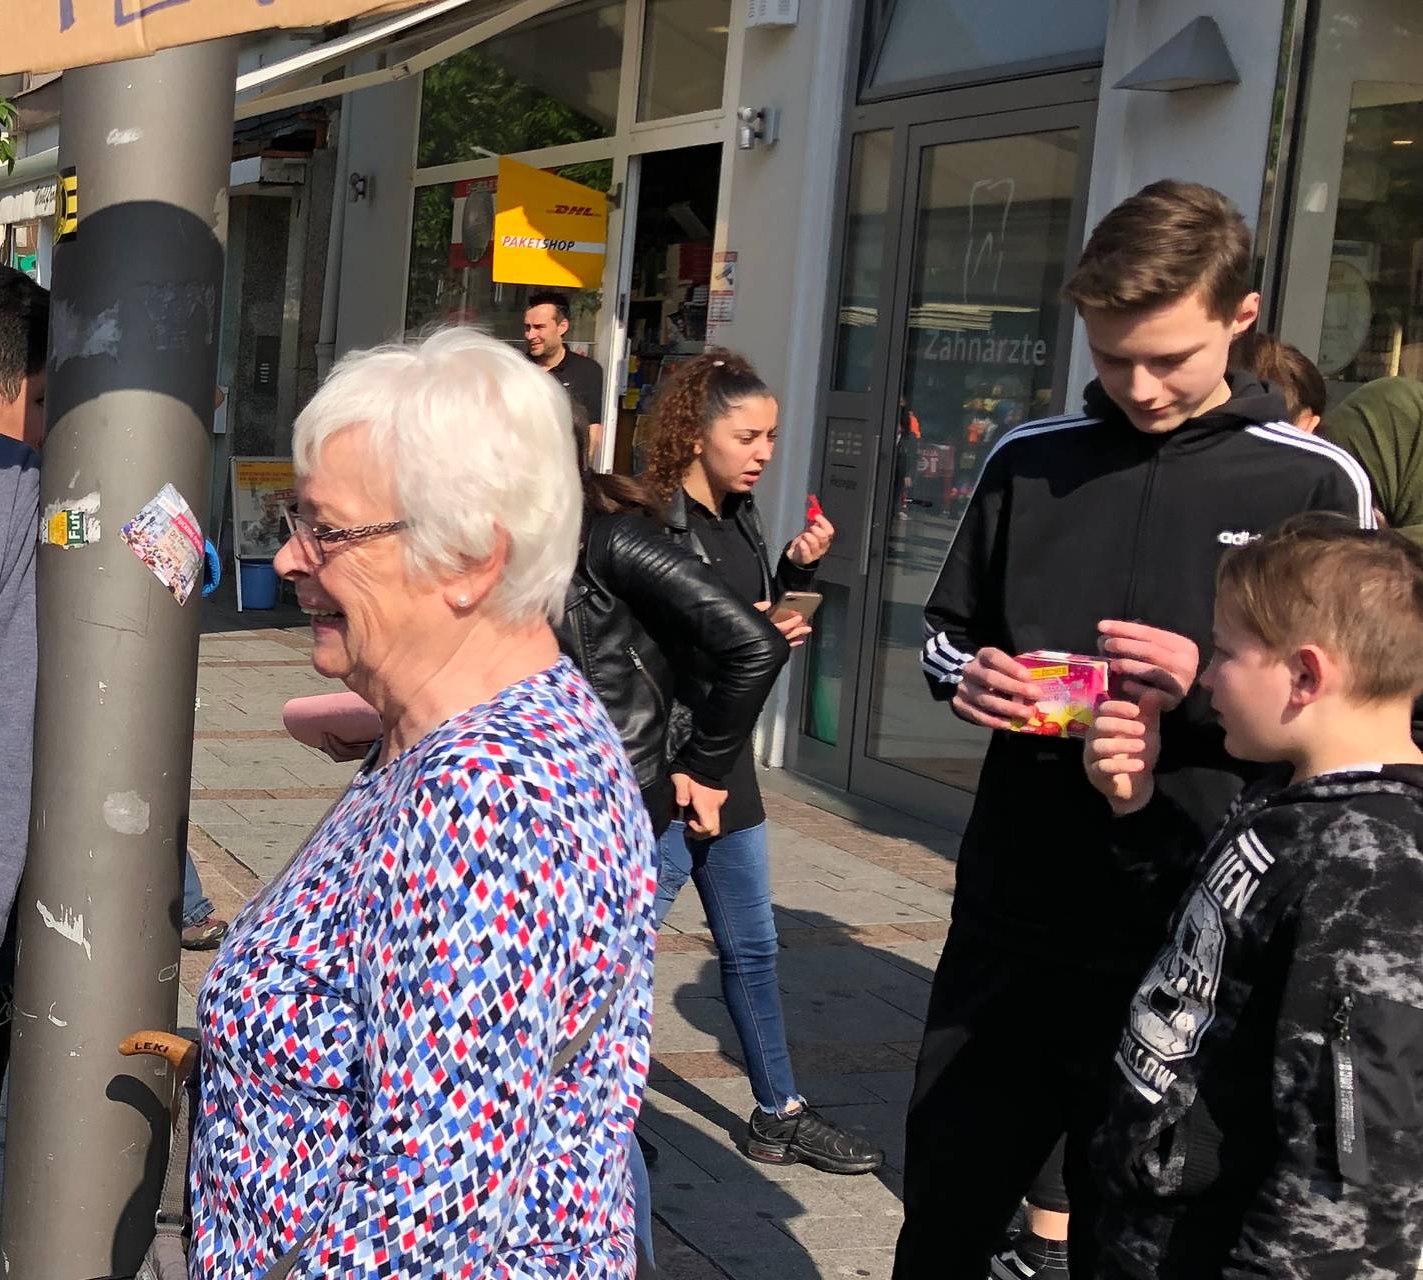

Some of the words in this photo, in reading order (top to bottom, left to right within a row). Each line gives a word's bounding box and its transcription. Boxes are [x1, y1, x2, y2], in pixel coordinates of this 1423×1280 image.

[553, 204, 594, 217] DHL
[502, 236, 575, 252] PAKETSHOP
[923, 330, 1047, 366] Zahnärzte
[135, 1042, 169, 1053] LEKI
